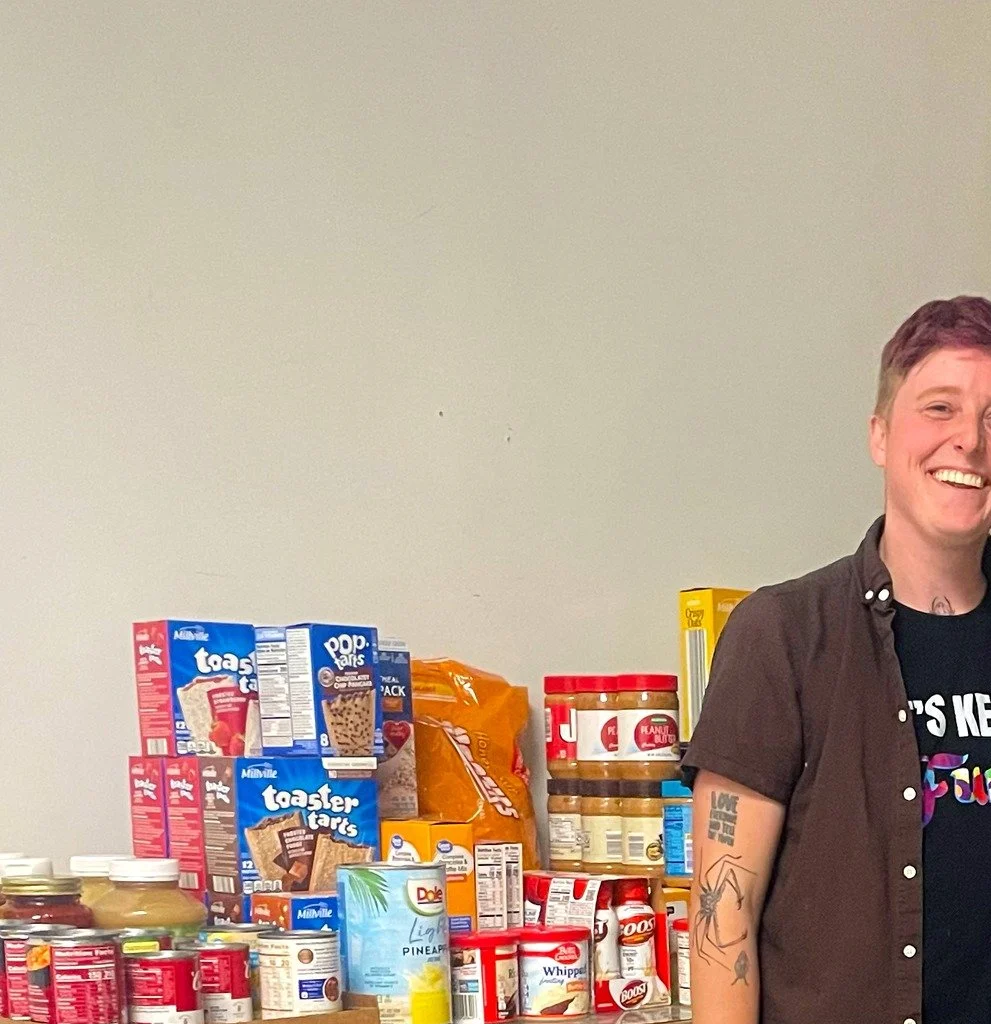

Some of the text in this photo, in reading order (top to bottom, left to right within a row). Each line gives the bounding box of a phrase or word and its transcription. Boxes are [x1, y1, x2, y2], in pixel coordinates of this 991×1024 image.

[173, 630, 210, 642] Millville
[907, 693, 947, 738] 'S
[640, 725, 670, 736] PEANUT
[320, 733, 329, 747] 8
[241, 768, 278, 779] Millville
[262, 783, 360, 814] toaster
[307, 811, 358, 837] tarts
[241, 860, 254, 869] 12
[416, 885, 443, 900] Dole
[297, 907, 334, 920] Millville
[621, 982, 648, 1003] BOOST
